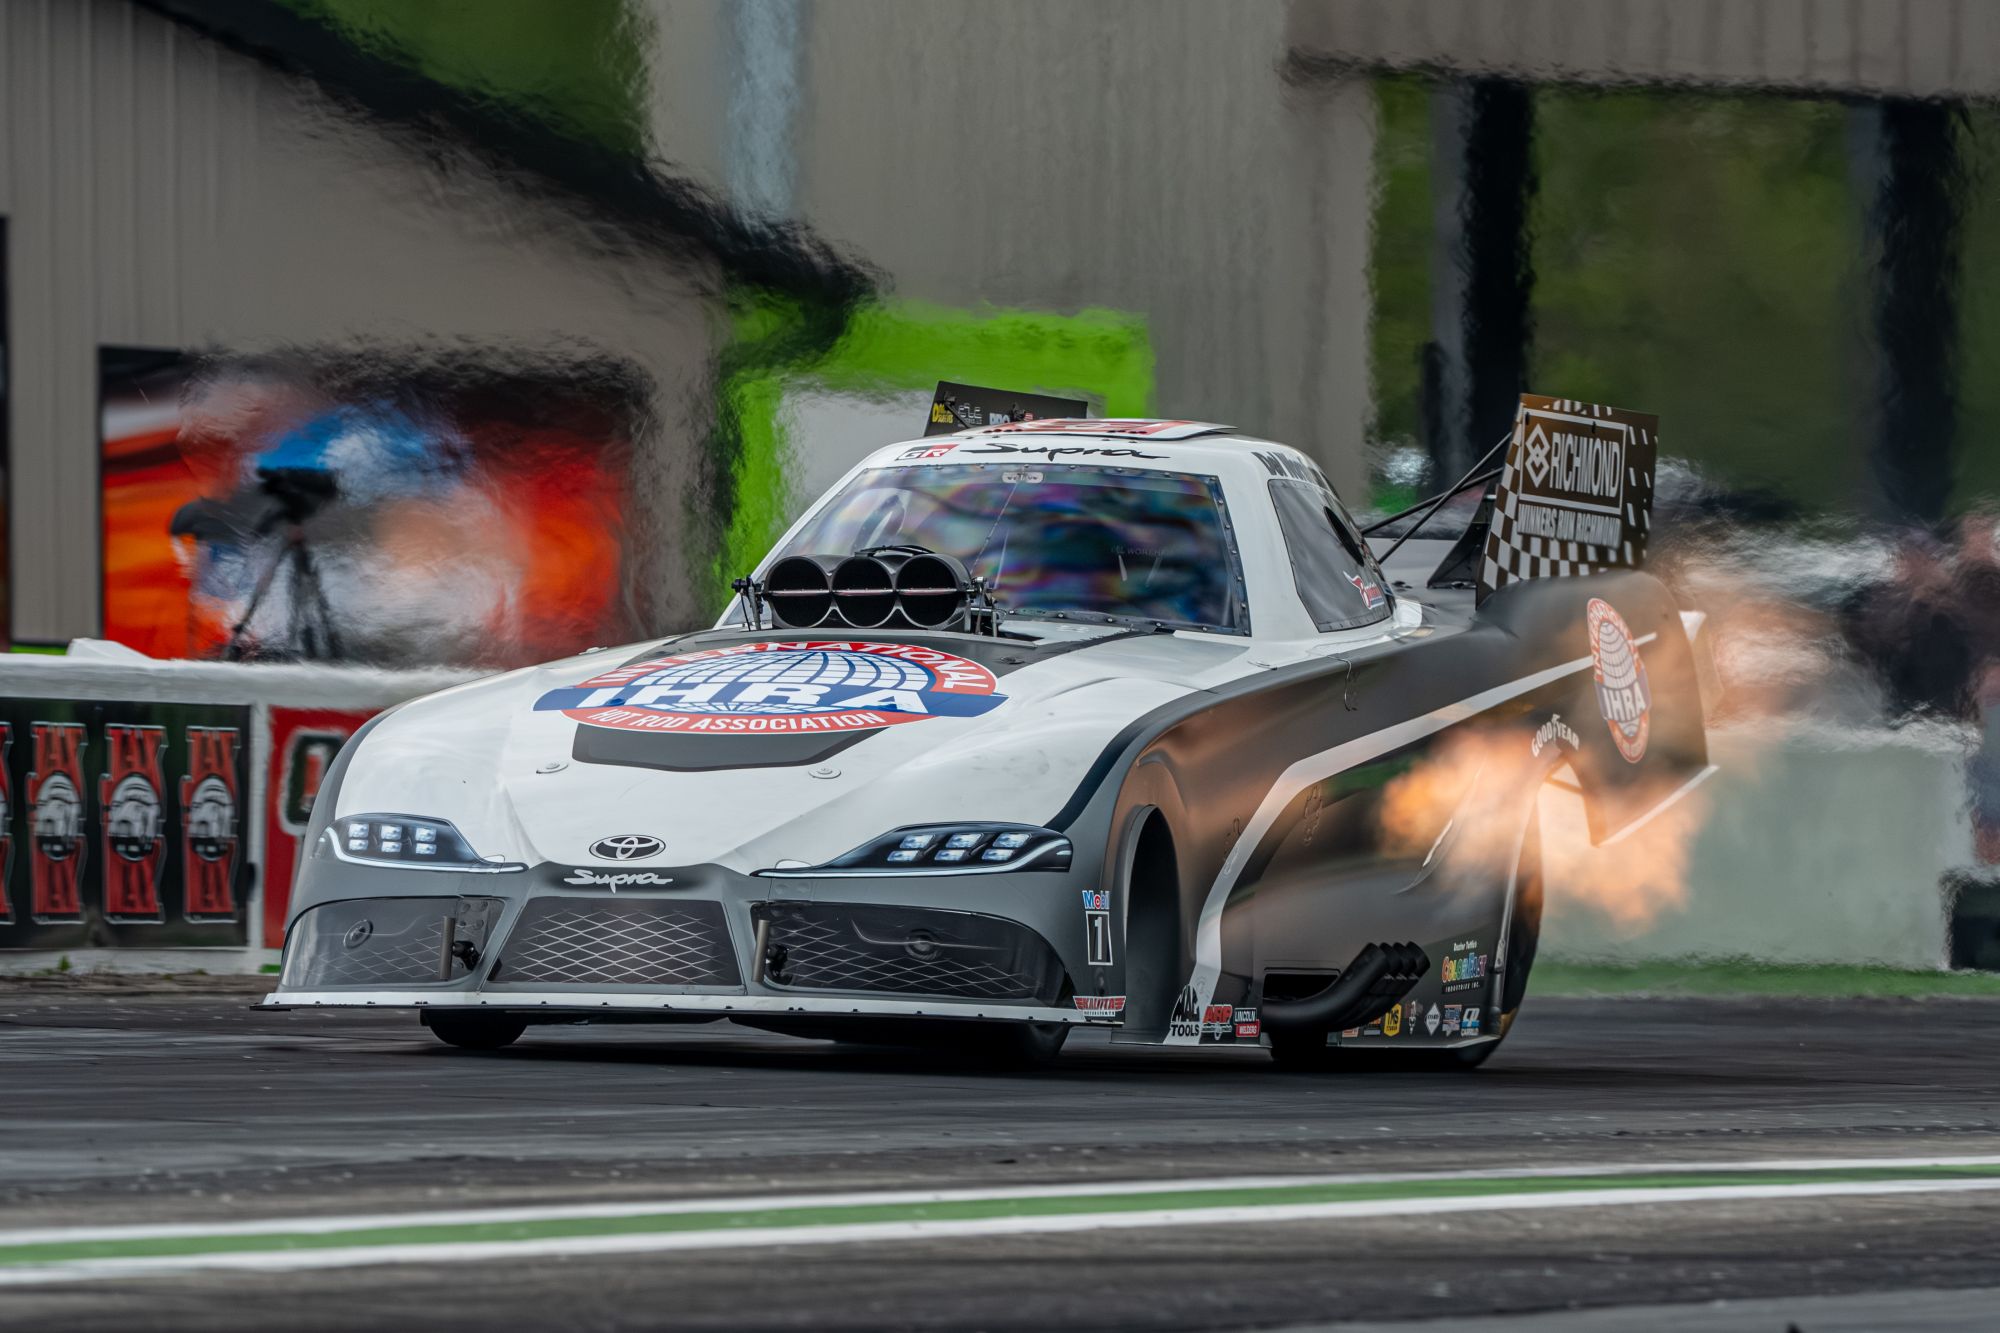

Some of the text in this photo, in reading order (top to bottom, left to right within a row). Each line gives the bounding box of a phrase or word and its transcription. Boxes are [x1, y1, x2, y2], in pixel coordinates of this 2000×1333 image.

[898, 446, 949, 461] GR
[960, 443, 1171, 461] Supra
[1549, 431, 1622, 498] RICHMOND
[1517, 503, 1622, 549] WINNERS RUN RICHMOND
[588, 641, 970, 690] INTERNATIONAL
[577, 681, 929, 714] IHRA
[1602, 680, 1647, 722] IHRA
[588, 711, 887, 730] HOT ROD ASSOCIATION
[563, 868, 674, 894] Supra
[1082, 890, 1110, 909] Mobil
[1094, 916, 1103, 961] 1
[1202, 1005, 1233, 1024] ARP
[1234, 1009, 1256, 1023] LINCOLN
[1171, 1024, 1200, 1037] TOOLS
